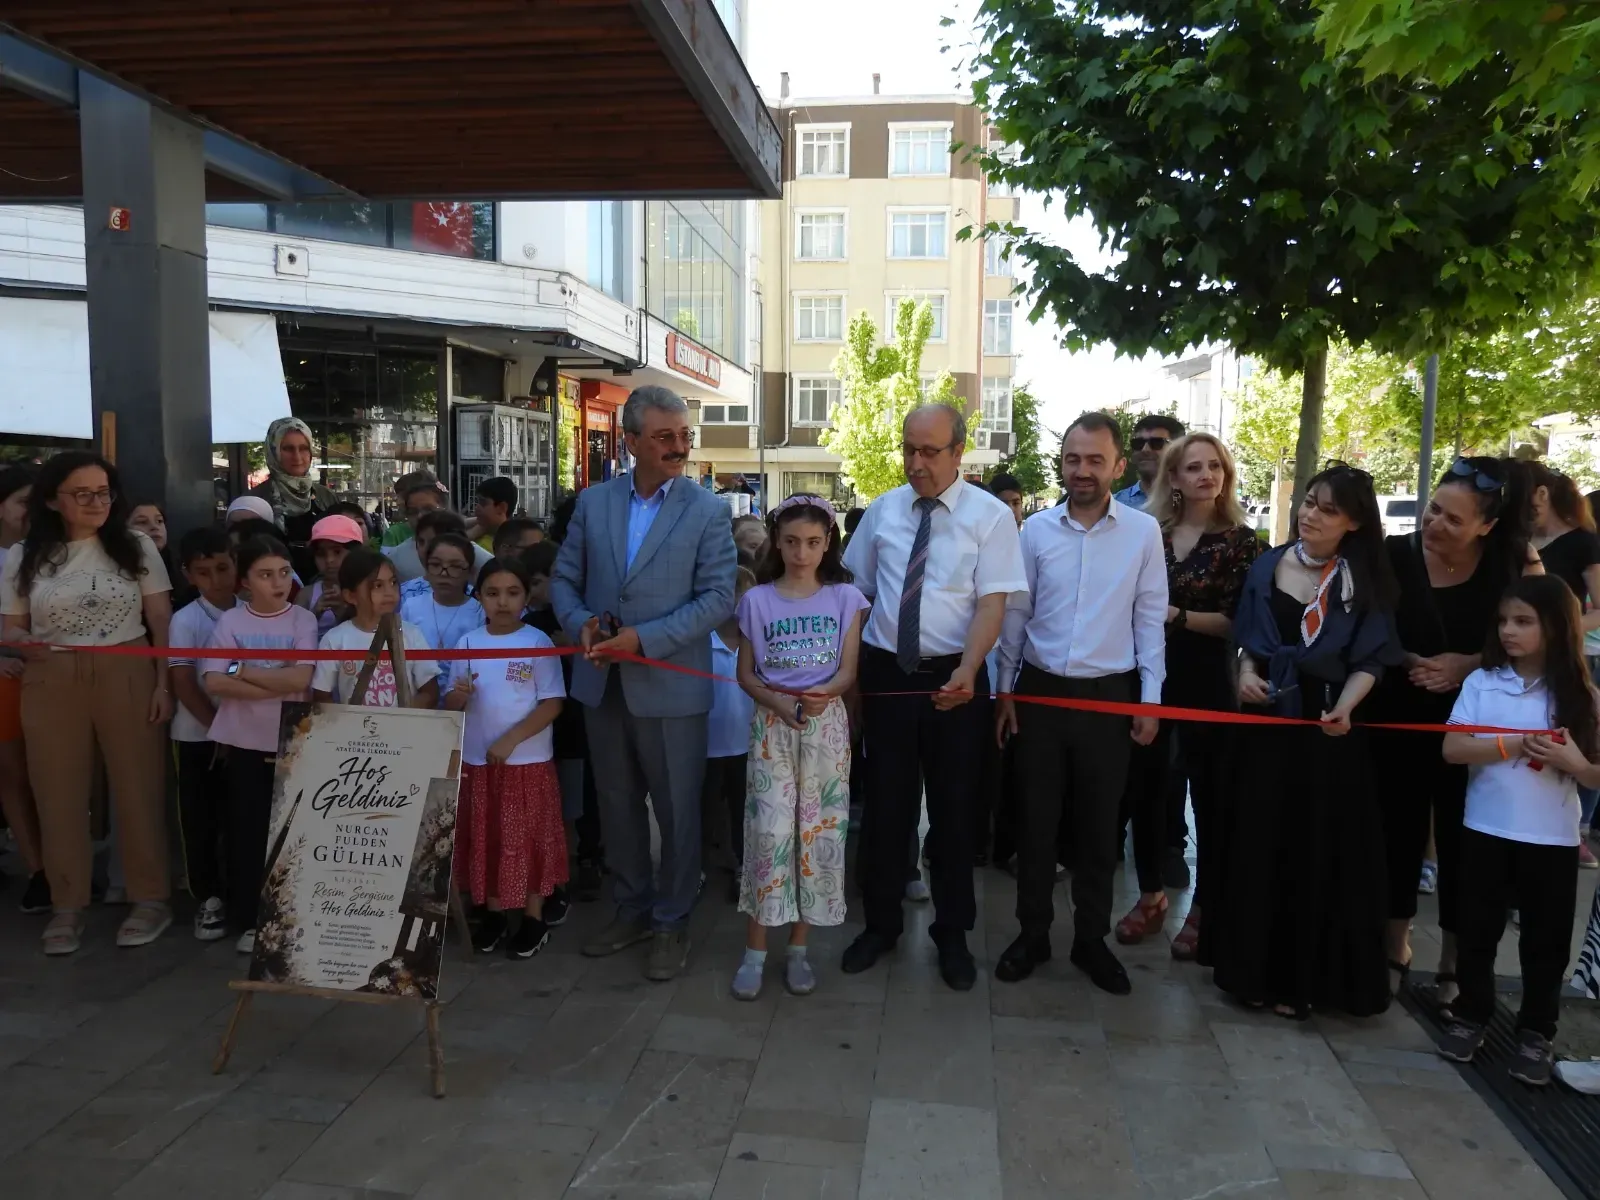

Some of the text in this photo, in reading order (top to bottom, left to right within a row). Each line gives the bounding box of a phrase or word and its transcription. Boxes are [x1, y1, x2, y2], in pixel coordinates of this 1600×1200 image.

[764, 616, 837, 642] UNITED
[769, 636, 832, 653] COLORS OF
[764, 648, 837, 669] BENETTON
[336, 746, 366, 754] ATATÜRK
[339, 757, 392, 786] Hoş
[312, 778, 412, 819] Geldiniz
[336, 824, 389, 836] NURCAN
[335, 836, 387, 848] FULDEN
[313, 845, 404, 868] GÜLHAN
[312, 882, 395, 904] Resim Sergisine
[321, 901, 386, 918] Hoş Geldiniz
